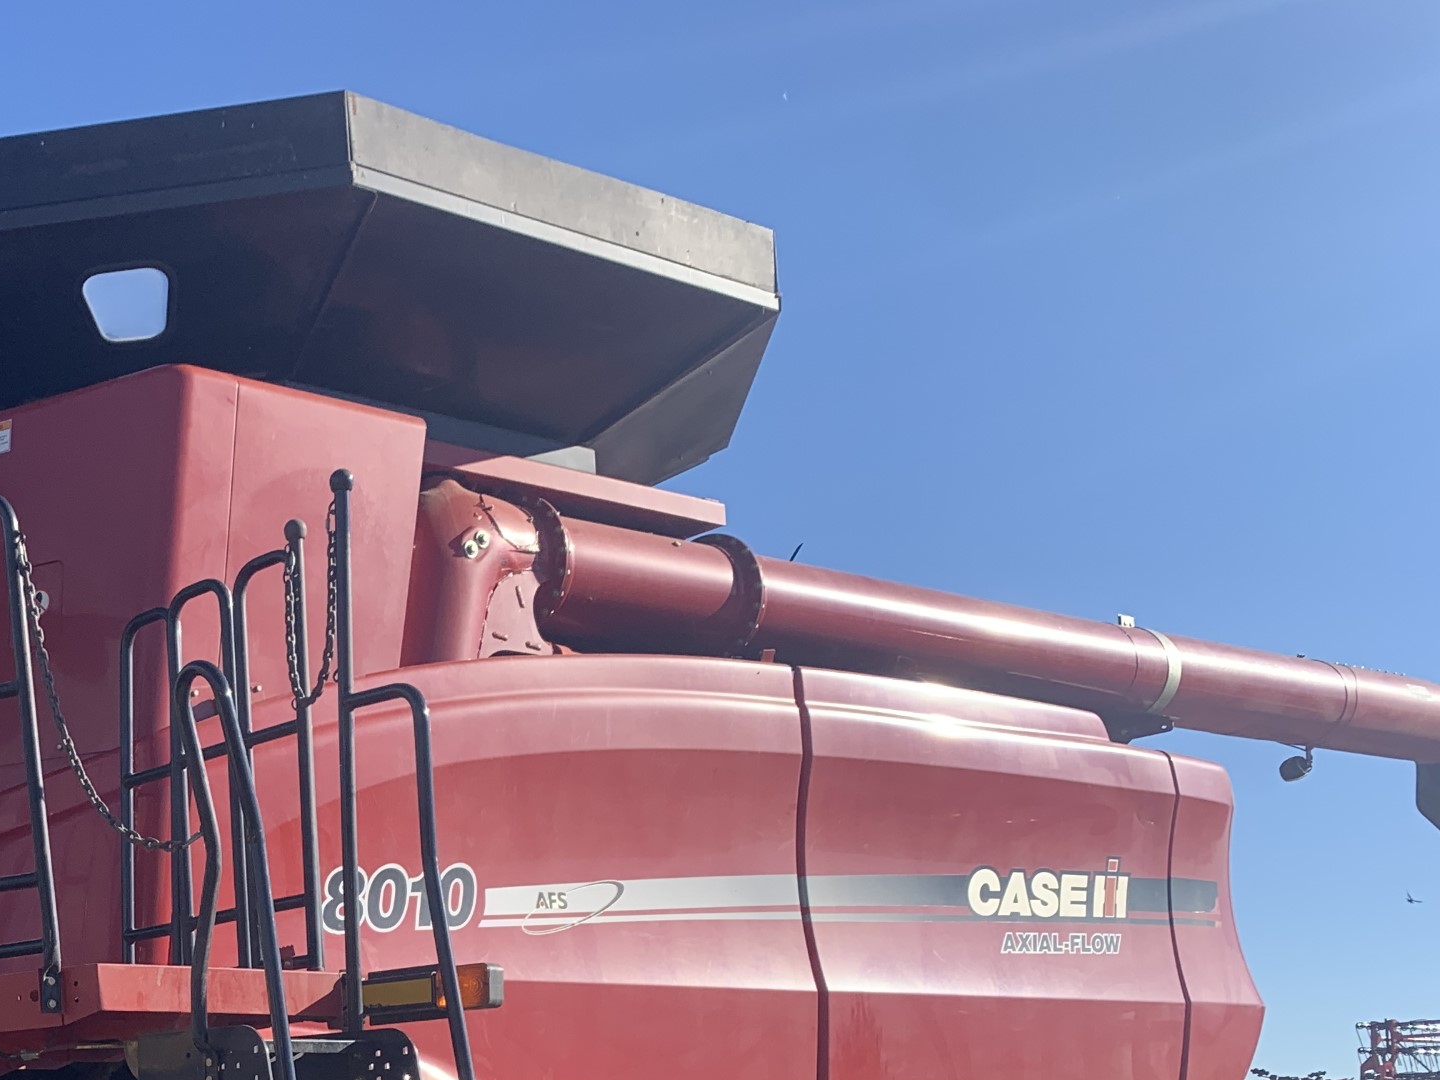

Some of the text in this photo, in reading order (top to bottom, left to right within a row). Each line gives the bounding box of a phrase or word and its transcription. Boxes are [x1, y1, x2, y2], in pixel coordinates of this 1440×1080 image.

[321, 862, 478, 936] 8010
[536, 890, 569, 911] AFS
[968, 868, 1089, 918] CASE
[1000, 931, 1122, 955] AXIAL-FLOW
